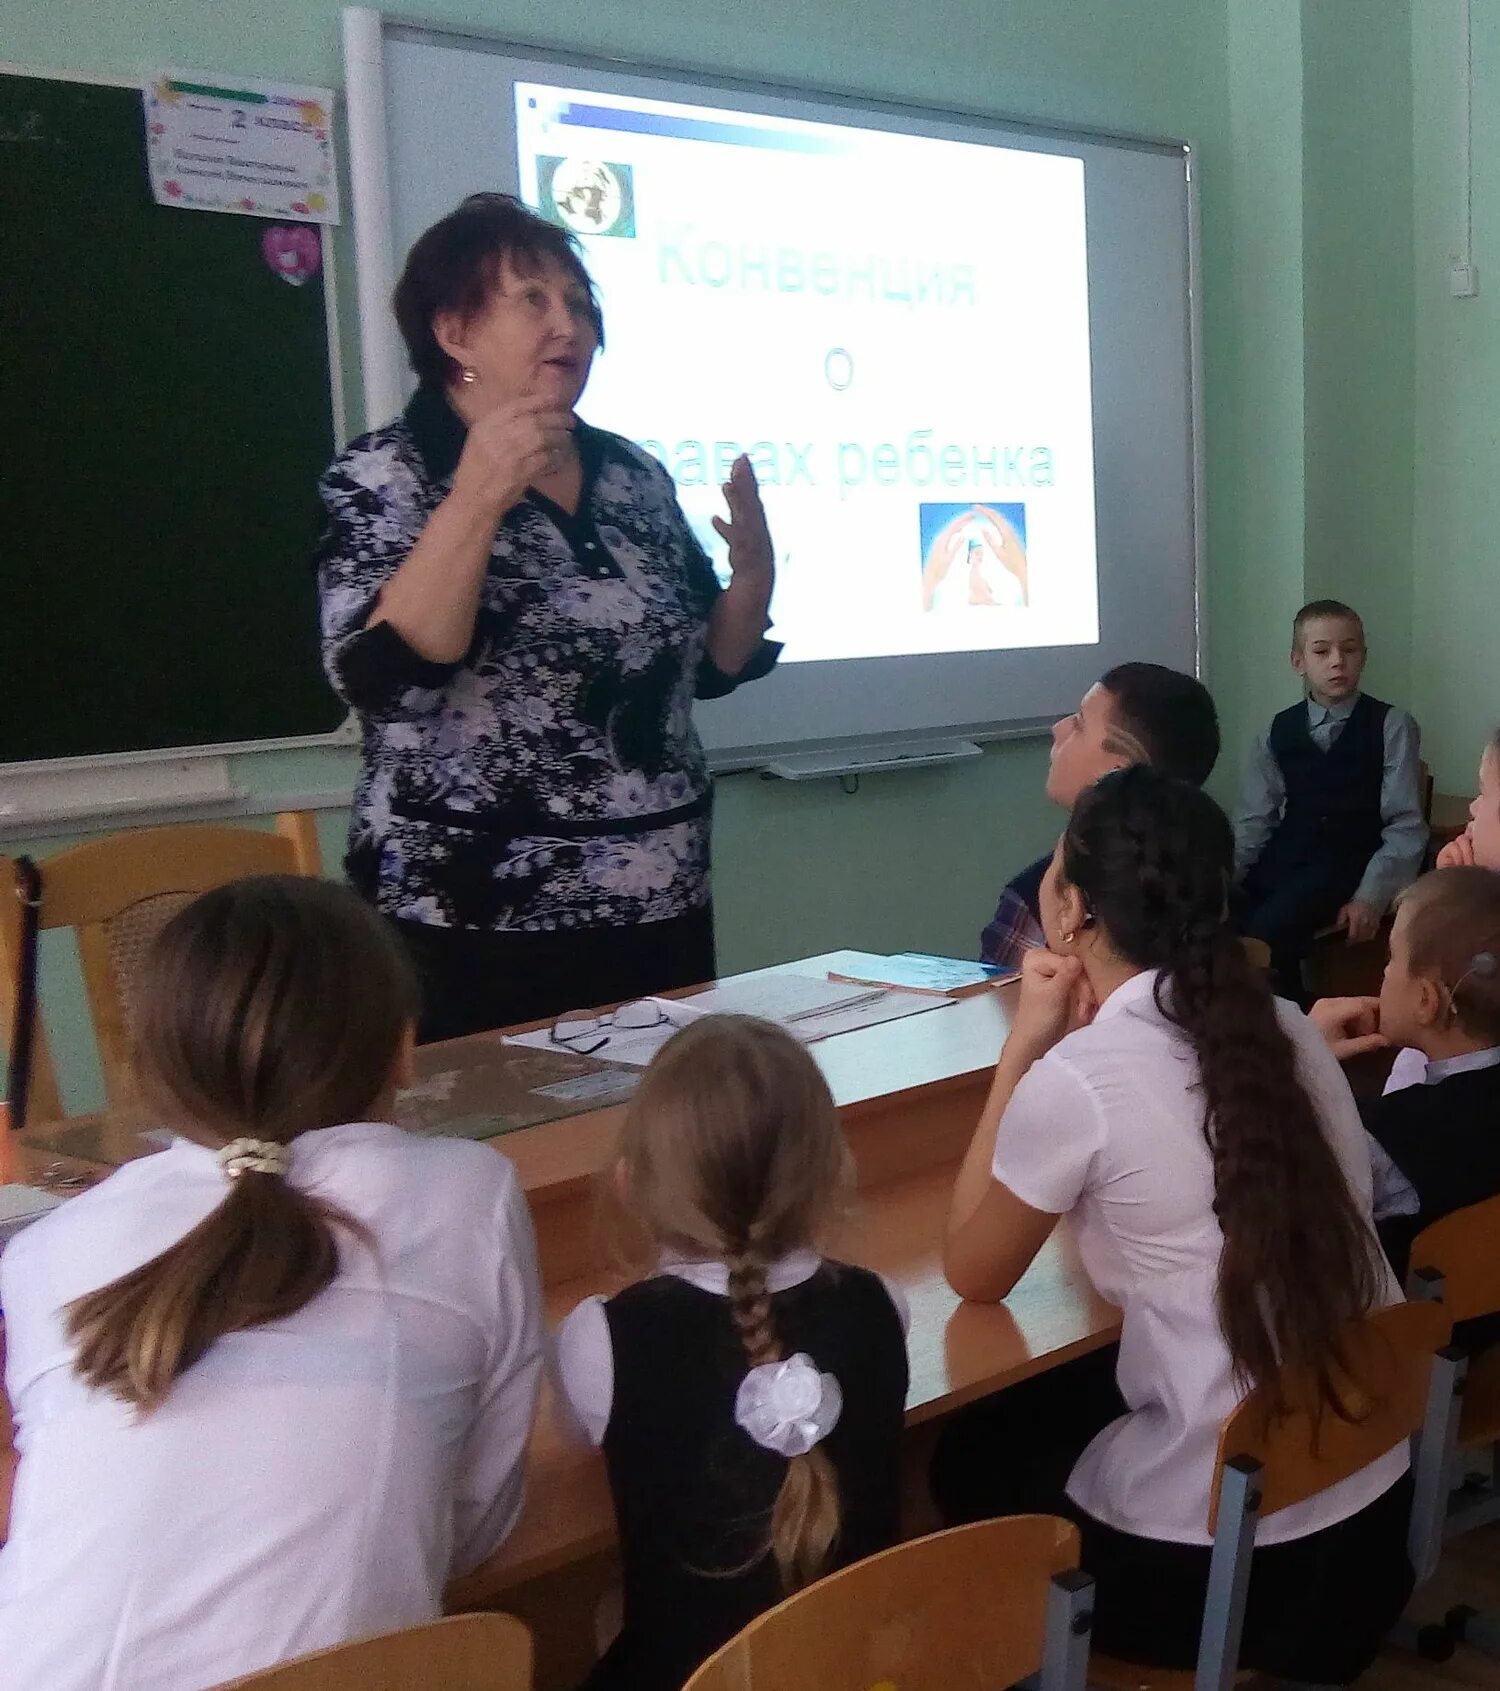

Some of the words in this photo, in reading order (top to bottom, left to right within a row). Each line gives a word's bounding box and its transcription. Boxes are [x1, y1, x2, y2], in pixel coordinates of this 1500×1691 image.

[231, 109, 247, 129] 2
[656, 224, 979, 309] Конвенция
[636, 439, 817, 487] авах
[838, 428, 1057, 501] ребенка
